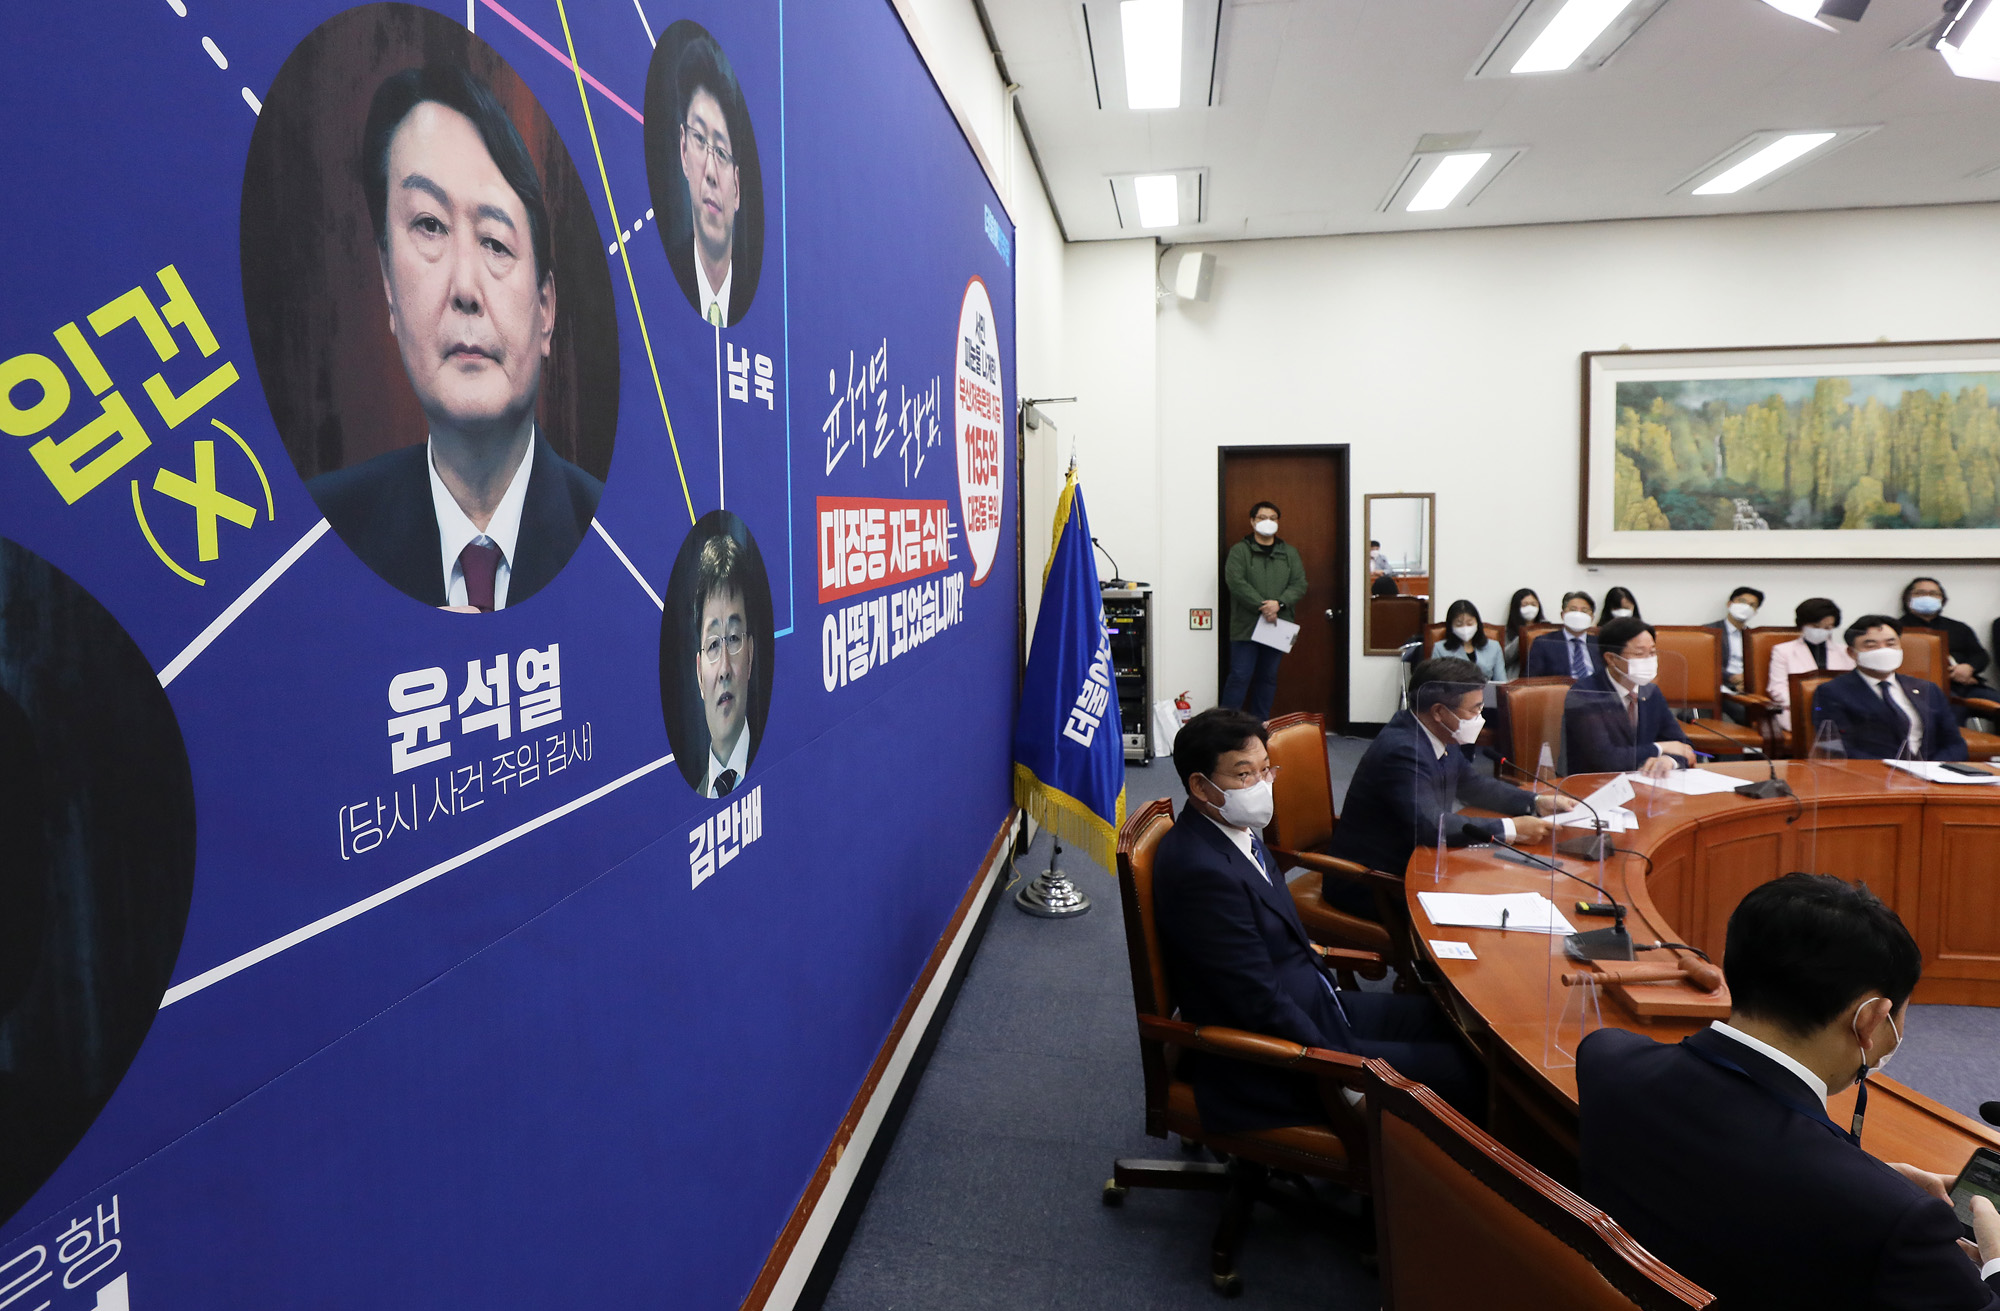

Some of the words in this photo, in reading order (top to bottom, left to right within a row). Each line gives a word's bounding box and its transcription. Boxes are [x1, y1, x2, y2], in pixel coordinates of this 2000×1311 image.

[0, 264, 240, 505] 입건
[822, 337, 895, 477] 윤석열
[965, 424, 999, 489] 1155억
[820, 508, 886, 589] 대장동
[968, 495, 986, 532] 대장동
[988, 495, 999, 530] 유입
[822, 595, 889, 693] 어떻게
[891, 571, 964, 660] 되었습니까?
[387, 643, 563, 775] 윤석열
[428, 761, 485, 822] 사건
[491, 741, 541, 795] 주임
[688, 784, 763, 891] 김만배
